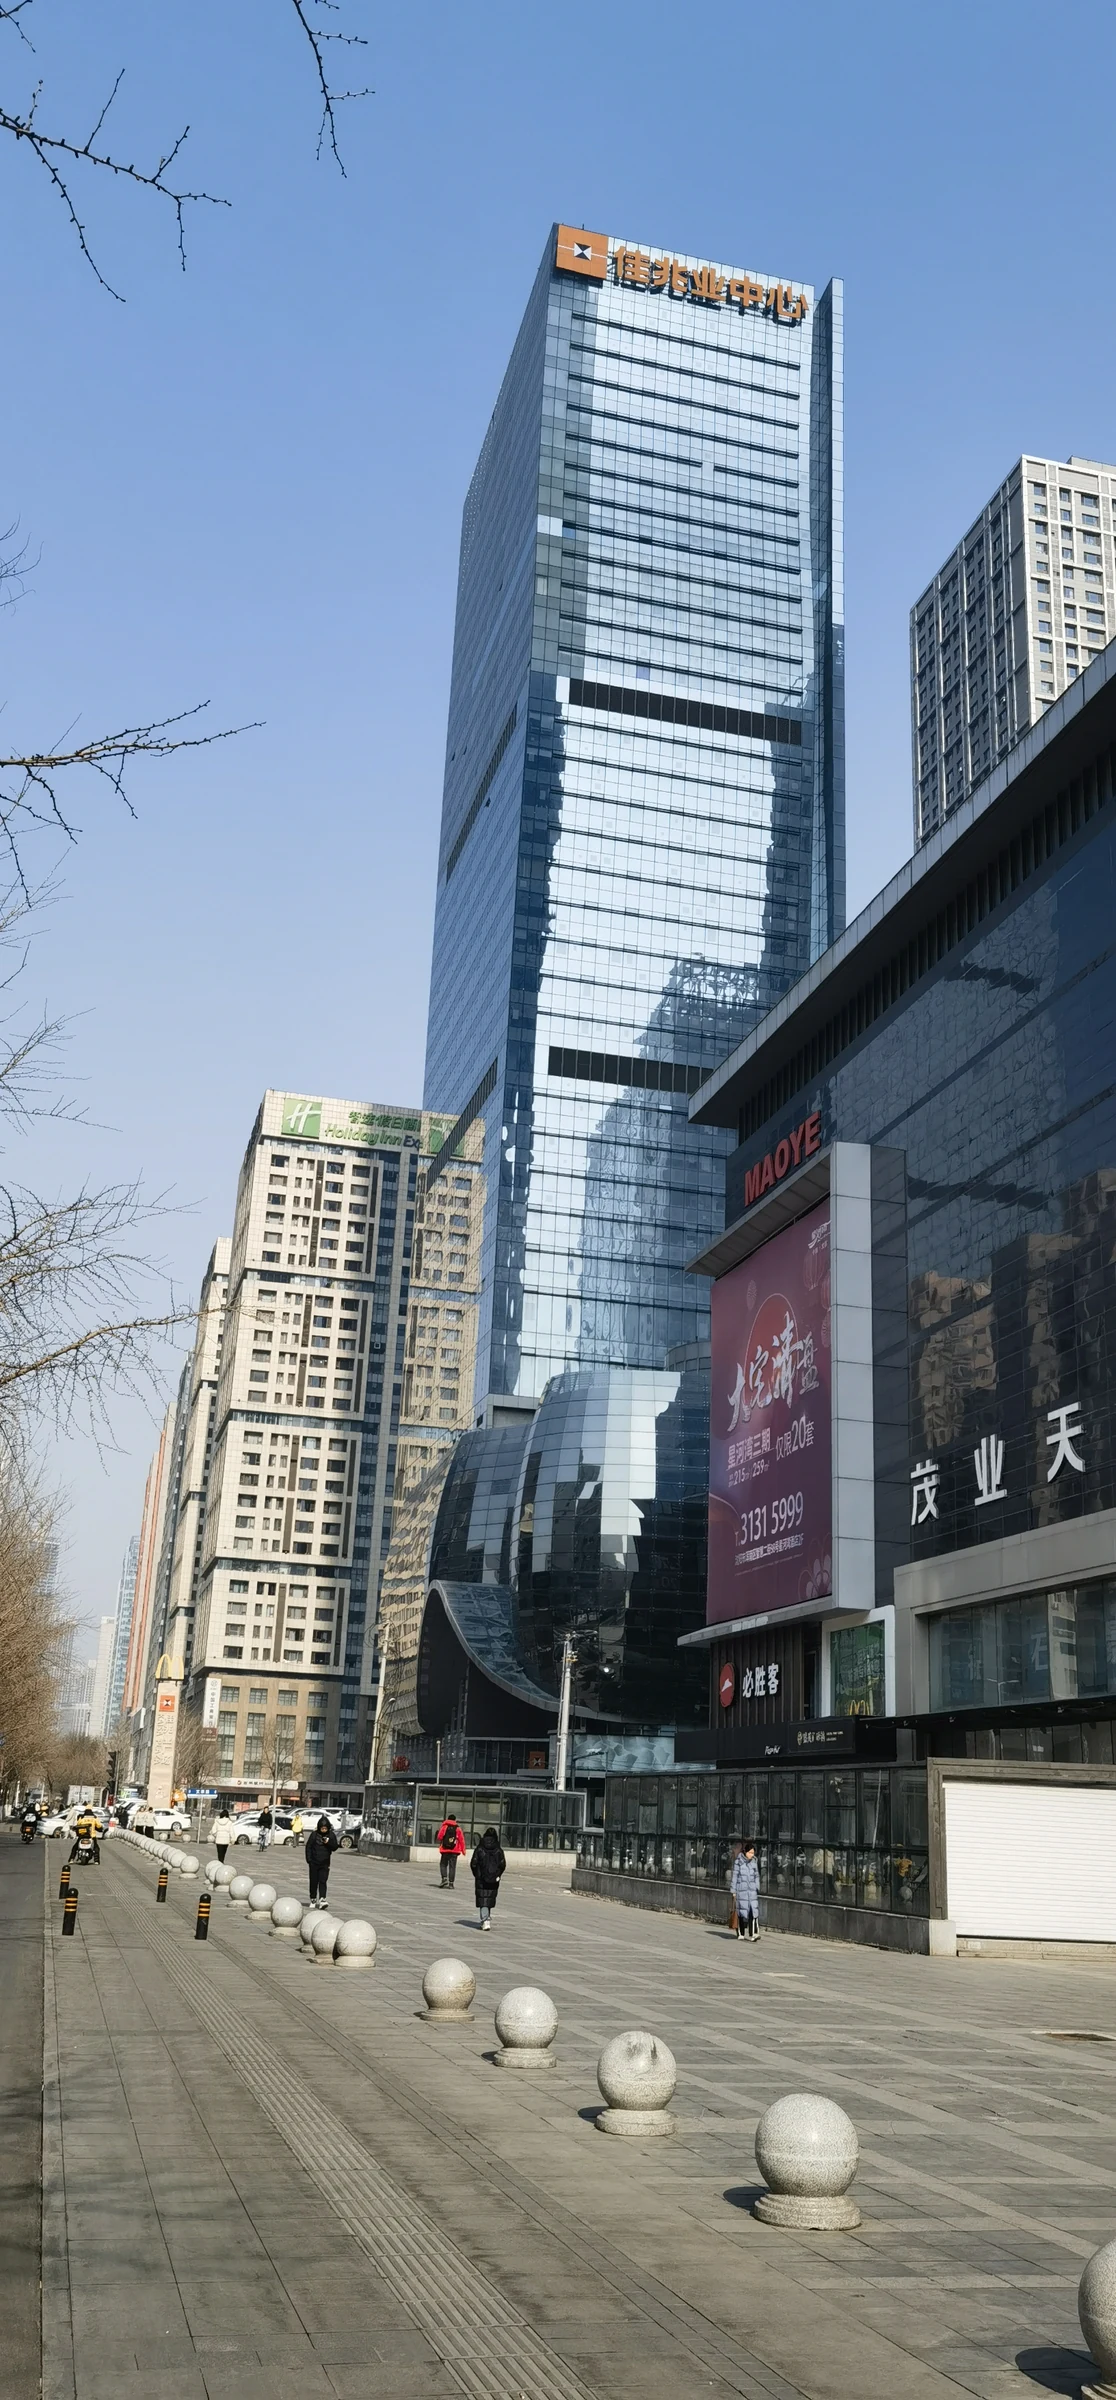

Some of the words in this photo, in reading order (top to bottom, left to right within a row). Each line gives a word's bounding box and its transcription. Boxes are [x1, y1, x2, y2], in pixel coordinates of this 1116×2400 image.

[614, 246, 809, 319] 佳兆业中心
[325, 1123, 379, 1146] Holiday
[380, 1129, 402, 1146] Inn
[348, 1110, 421, 1133] 智选假日酒
[744, 1110, 821, 1207] MAOYE
[728, 1427, 771, 1468] 星河湾三期
[775, 1415, 815, 1461] 仅限20套
[910, 1401, 1086, 1526] 茂业天
[771, 1491, 804, 1535] 5999
[742, 1662, 779, 1698] 必胜客
